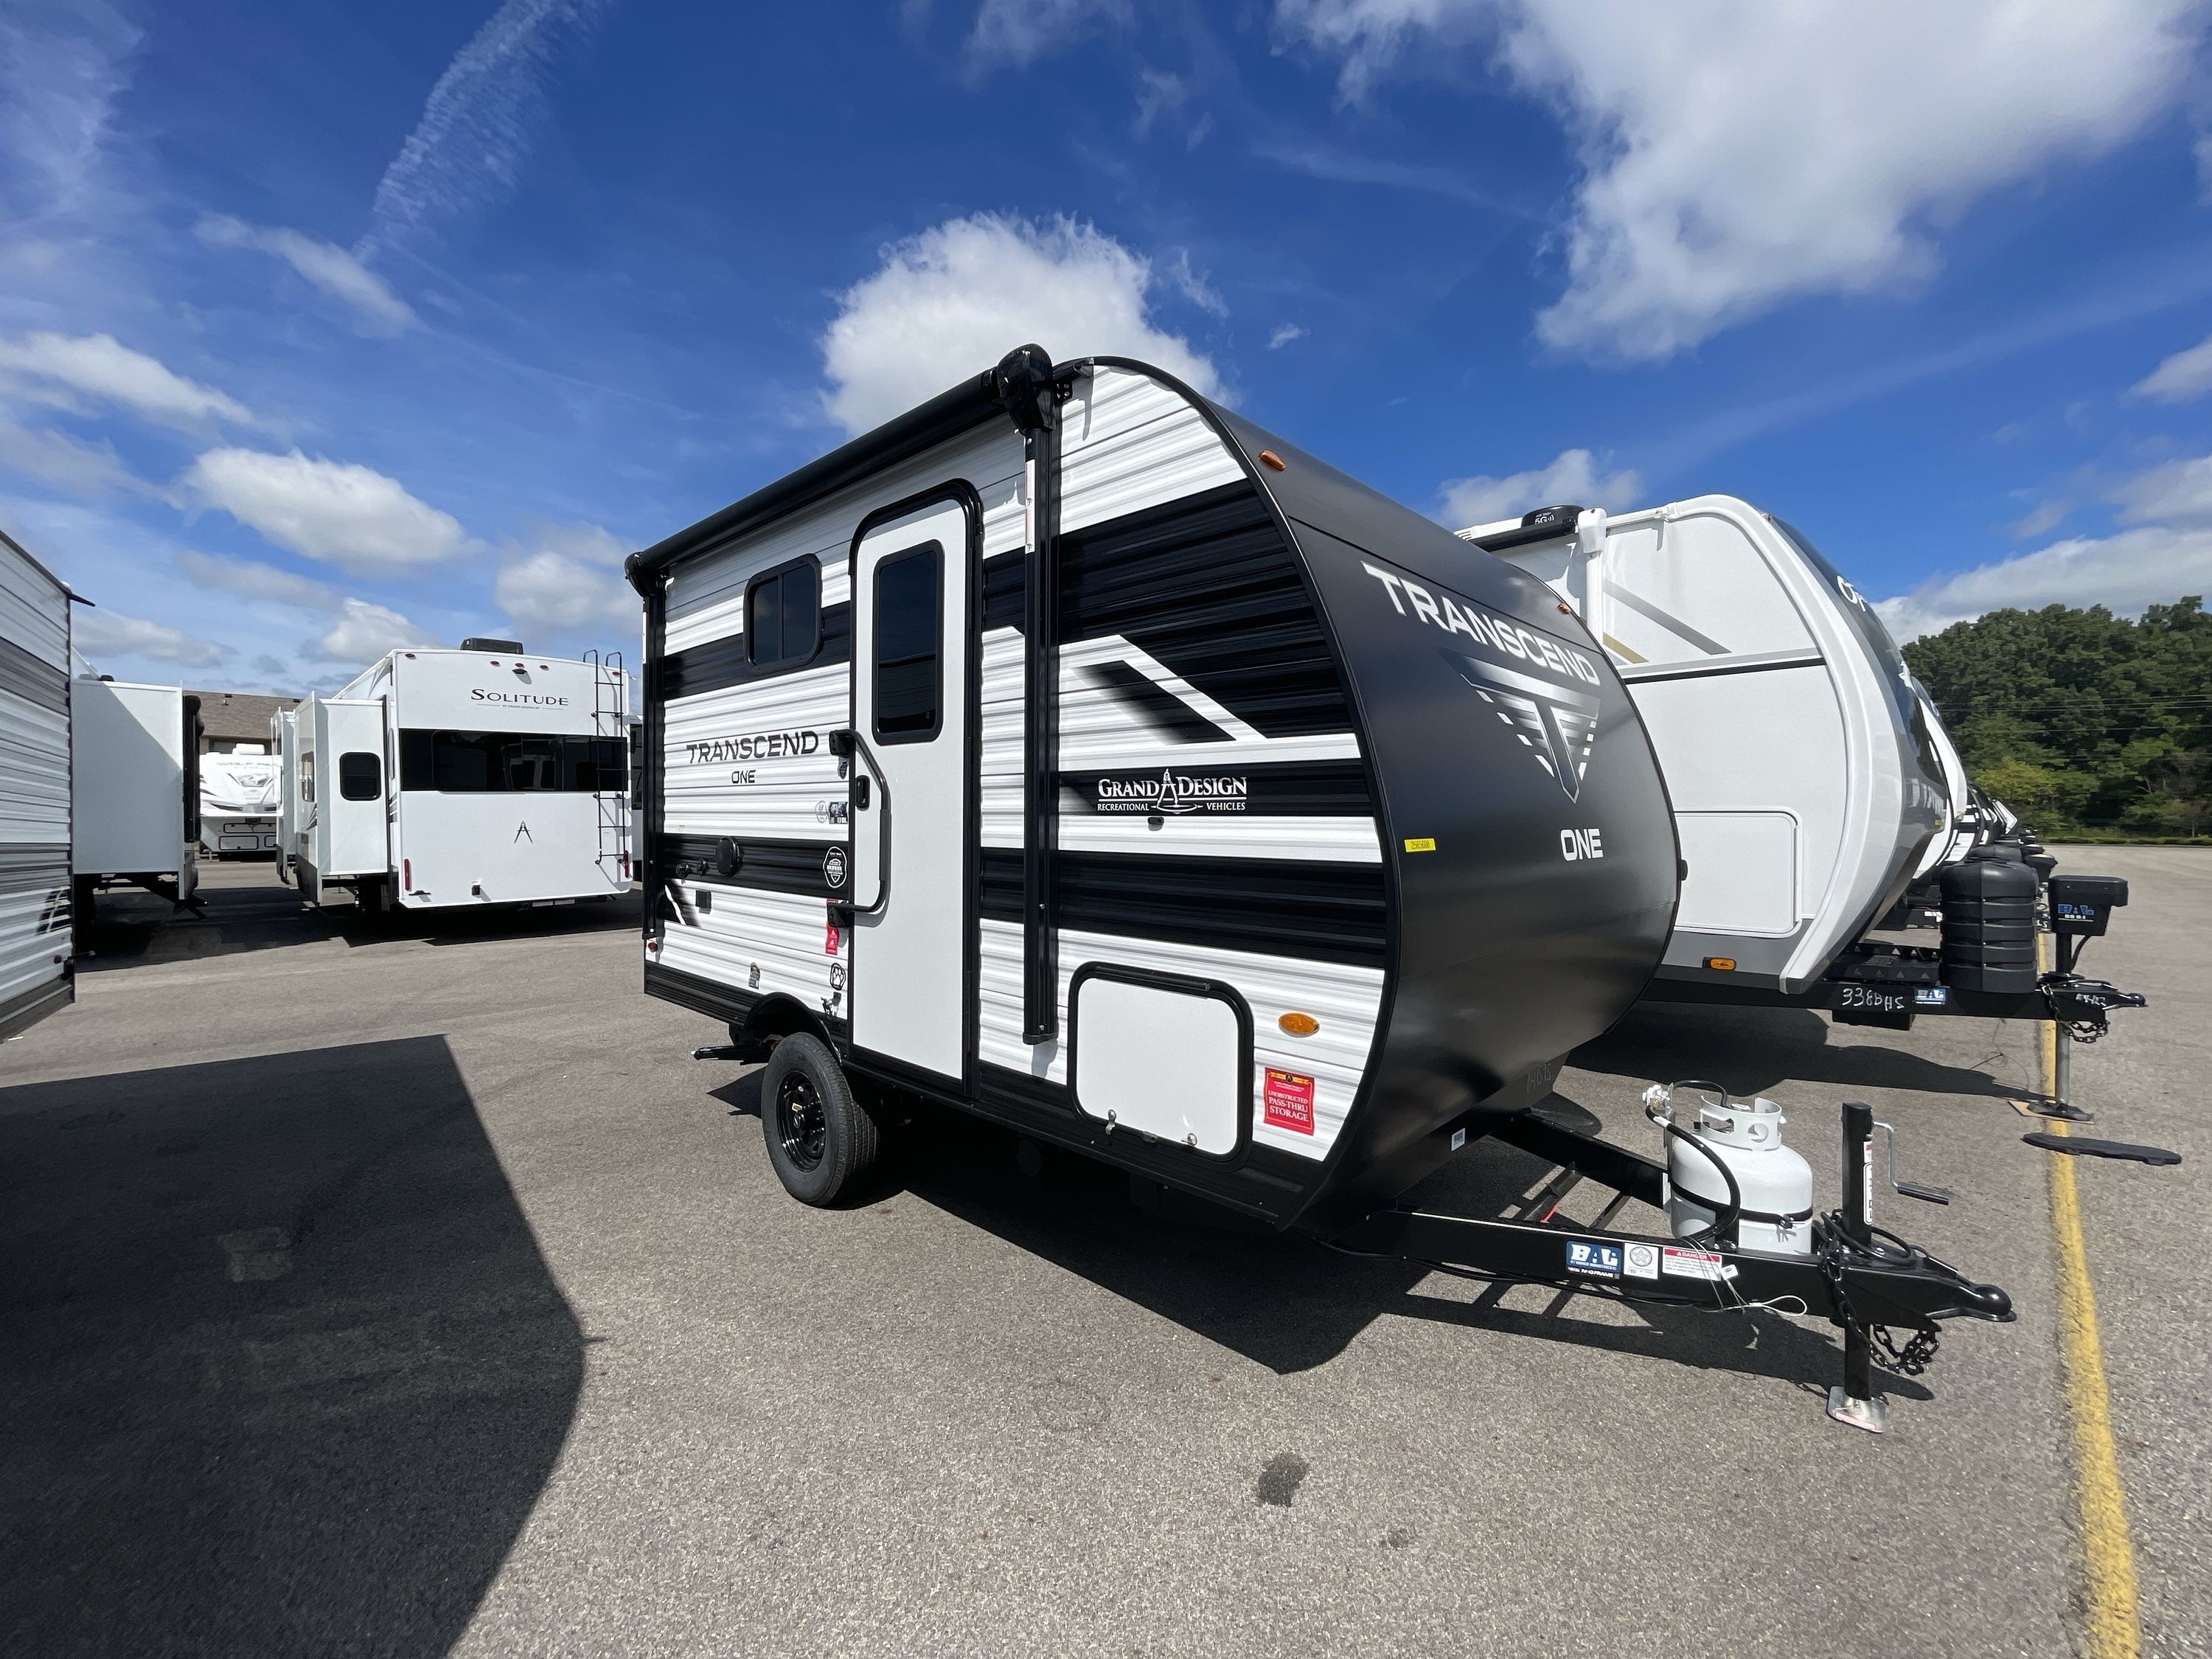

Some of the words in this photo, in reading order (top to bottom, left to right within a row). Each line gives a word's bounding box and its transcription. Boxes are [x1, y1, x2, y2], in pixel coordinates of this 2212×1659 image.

[1360, 560, 1601, 686] TRANSCEND
[471, 689, 568, 706] SOLITUDE
[686, 731, 819, 764] TRANSCEND
[731, 770, 756, 784] ONE
[1098, 779, 1160, 797] GRAND
[1175, 776, 1247, 796] DESIGN
[1097, 803, 1150, 811] RECREATIONAL
[1206, 802, 1246, 810] VEHICLES
[1560, 829, 1603, 861] ONE
[1268, 1090, 1309, 1105] UNOBSTRUCTED
[1268, 1096, 1308, 1113] PASS-THRU
[1270, 1105, 1309, 1121] STORAGE
[1571, 1244, 1618, 1267] BAL
[1682, 1252, 1708, 1260] DANGER
